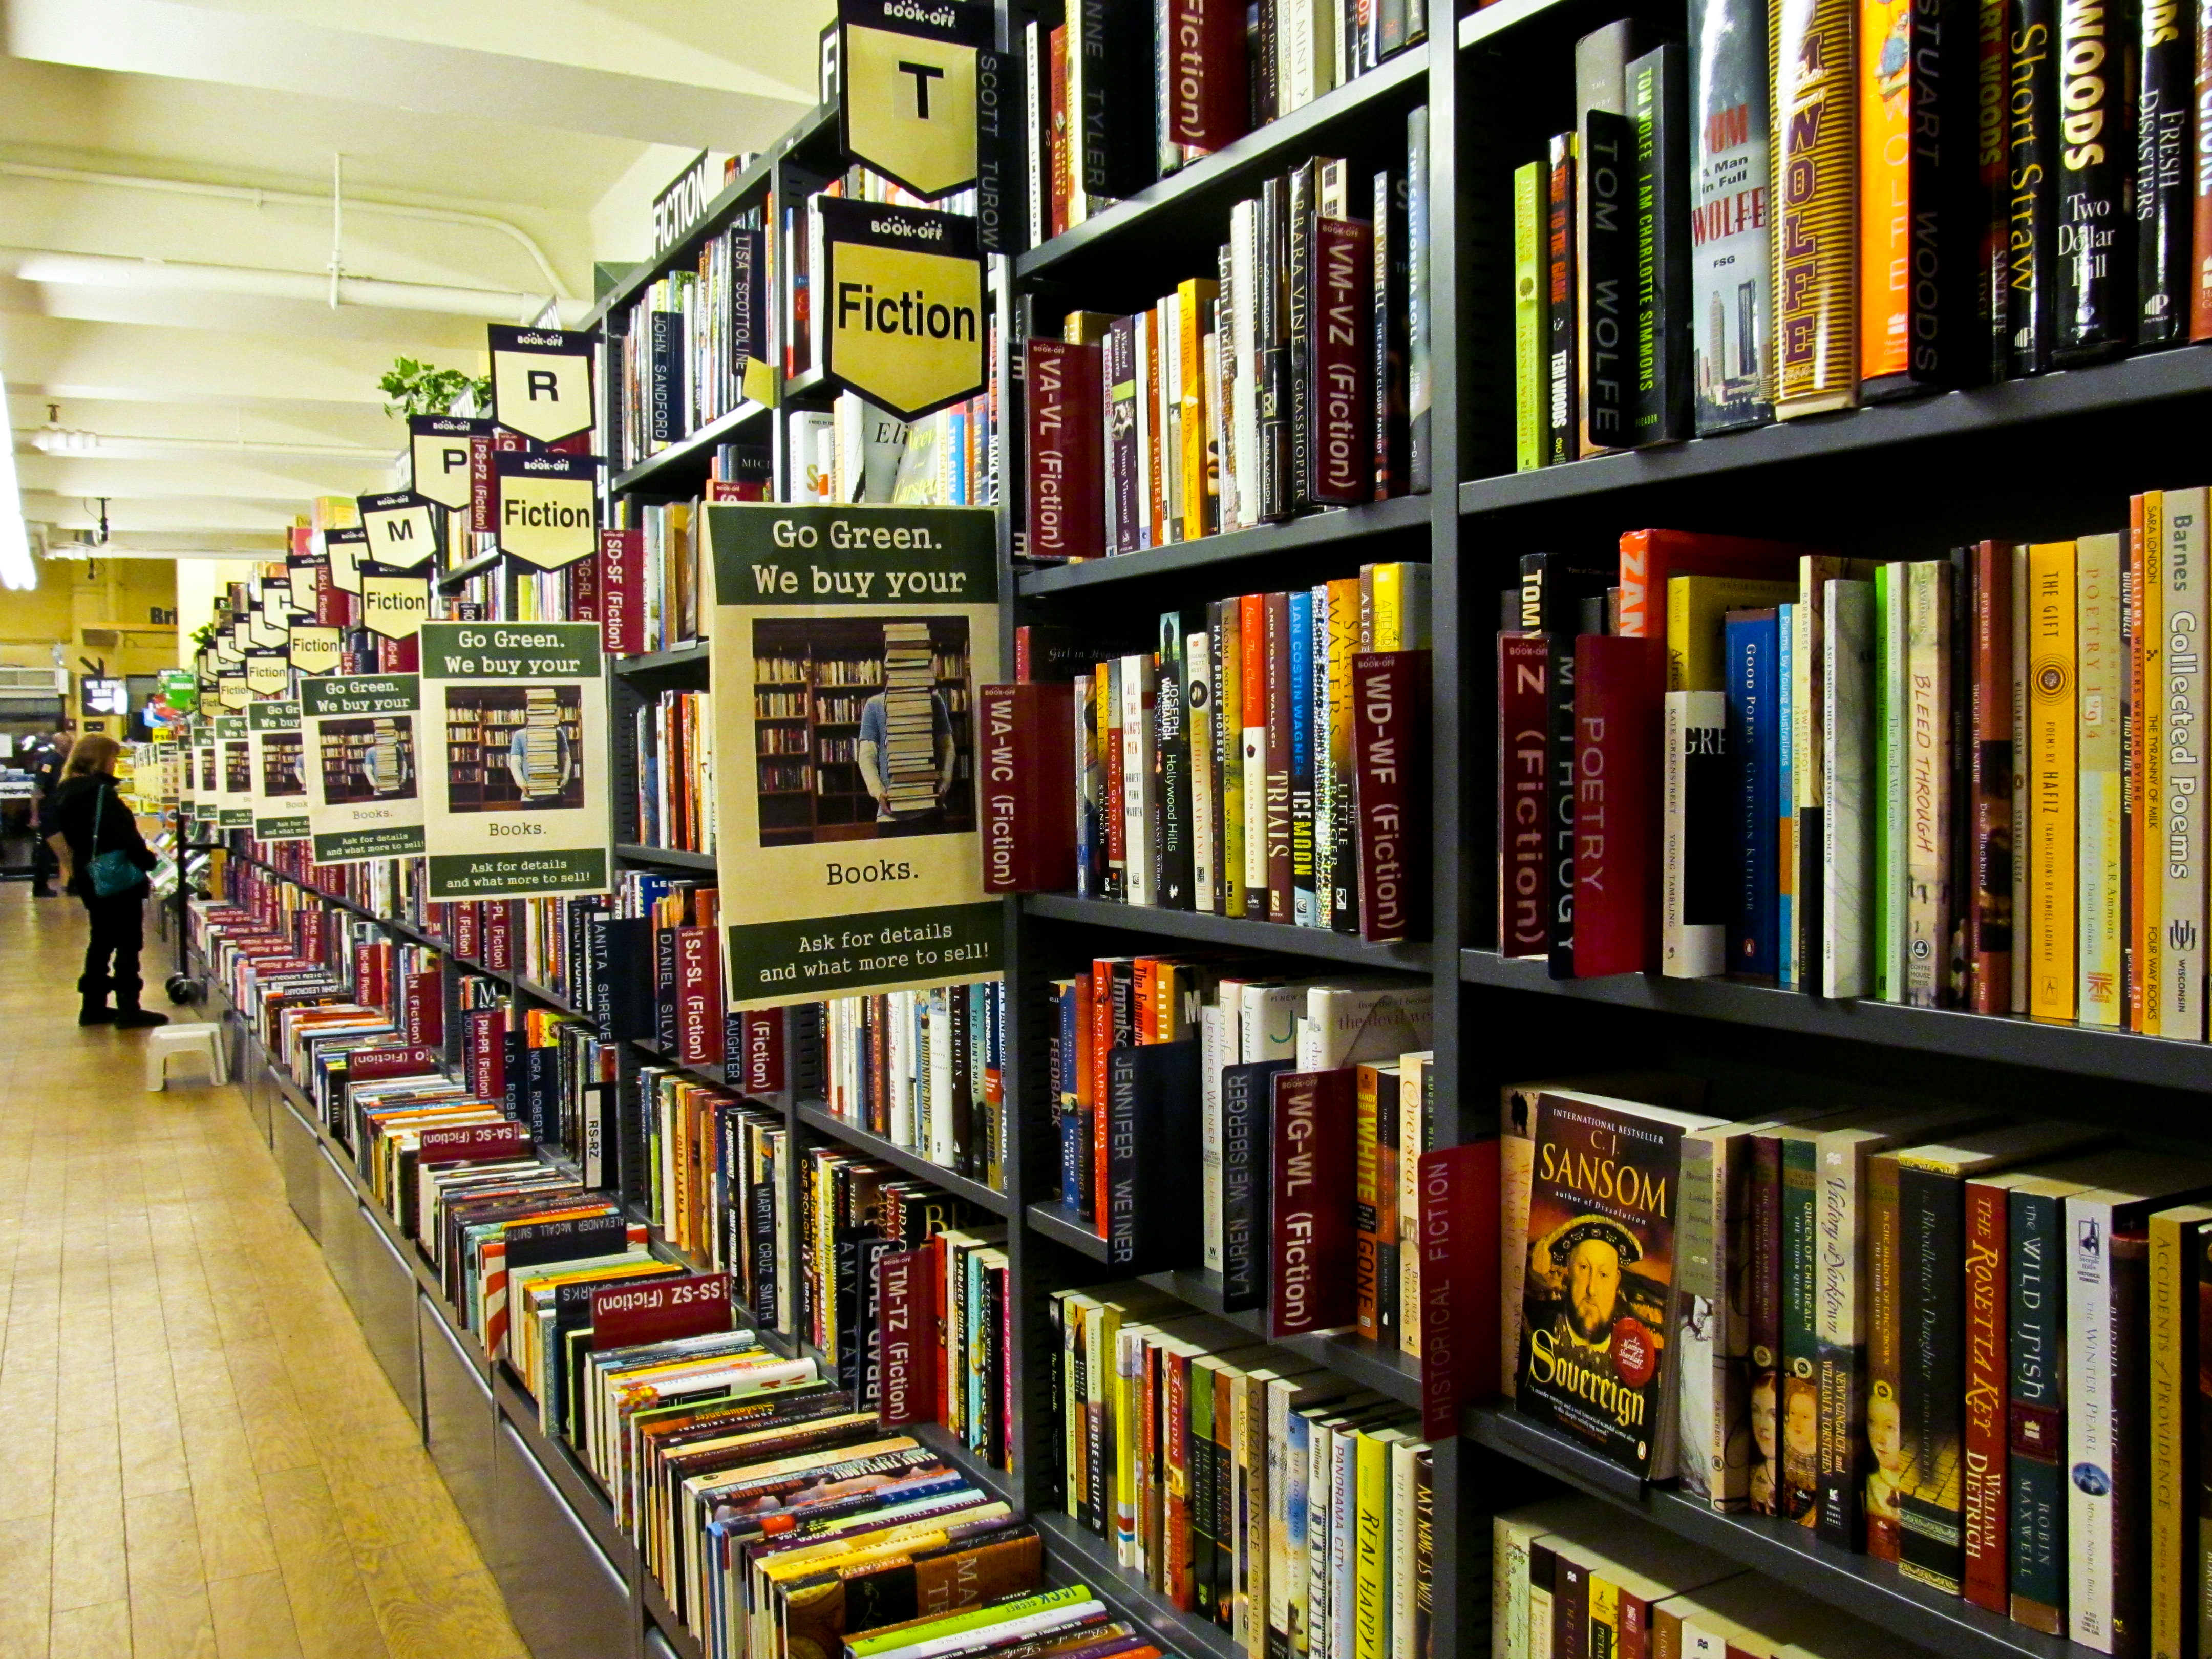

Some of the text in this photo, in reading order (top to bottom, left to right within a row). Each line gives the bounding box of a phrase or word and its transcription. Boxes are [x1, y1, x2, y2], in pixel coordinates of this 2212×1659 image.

[899, 60, 944, 119] T
[1637, 67, 1652, 104] TOM
[981, 55, 999, 249] SCOTT TUROW
[1637, 109, 1652, 161] WOLFE
[2010, 24, 2047, 293] Short Straw
[2136, 89, 2159, 221] DISASTERS
[2158, 110, 2185, 189] FRESH
[1714, 156, 1749, 174] Man
[1719, 169, 1747, 187] Full
[652, 157, 709, 259] FICTION
[1638, 186, 1652, 211] AM
[1693, 186, 1766, 246] WOLFE
[2067, 193, 2110, 222] Two
[1374, 179, 1385, 313] SARAH VOWELL
[1638, 215, 1652, 307] CHARLOTTE
[1713, 255, 1735, 268] FSG
[2058, 225, 2115, 256] Dollar
[736, 236, 750, 370] LISA SCOTTOLINE
[838, 282, 975, 342] Fiction
[1594, 139, 1620, 433] TOM WOLFE
[654, 315, 667, 438] JOHN SANDFORD
[1328, 243, 1356, 487] VM-VZ (Fiction)
[1639, 310, 1653, 391] SIMMONS
[527, 370, 559, 402] R
[443, 449, 467, 474] P
[1038, 358, 1064, 548] VA-VL (Fiction)
[1295, 379, 1305, 499] GRASSHOPPER
[474, 444, 487, 532] PS-PZ (Fiction)
[505, 499, 590, 528] Fiction
[387, 519, 414, 542] M
[773, 521, 943, 551] Go Green.
[607, 540, 622, 583] SD-SF
[752, 565, 967, 600] We buy your
[318, 569, 327, 624] LG-LL (Fiction)
[367, 592, 426, 610] Fiction
[292, 638, 338, 652] Fiction
[444, 656, 580, 675] We buy your
[458, 631, 565, 648] Go Green.
[249, 667, 286, 678] Fiction
[326, 681, 399, 694] Go Green.
[2168, 514, 2197, 880] Barnes Collected Poems
[317, 698, 410, 712] We buy your
[1161, 677, 1171, 740] WAMBAUGH
[1169, 681, 1179, 735] JOSEPH
[353, 809, 393, 819] Books.
[990, 700, 1015, 885] WA-WC (Fiction)
[1266, 771, 1289, 857] TRIALS
[1365, 673, 1405, 930] WD-WF (Fiction)
[1515, 663, 1546, 944] Z (Fiction)
[1581, 717, 1605, 891] POETRY
[327, 847, 342, 856] and
[345, 846, 365, 854] what
[405, 840, 424, 849] sell!
[342, 833, 408, 845] Ask for details
[489, 822, 547, 837] Books.
[446, 872, 590, 888] and what more to sell!
[471, 859, 567, 873] Ask for details
[826, 861, 920, 886] Books.
[759, 943, 989, 983] and what more to sell!
[799, 924, 953, 953] Ask for details
[594, 924, 612, 1041] ANITA SHREVE
[660, 934, 674, 1051] DANIEL SILVA
[685, 939, 706, 1060] SJ-SL (Fiction)
[2177, 959, 2188, 1013] WISCONSIN
[354, 1051, 426, 1065] O (Fiction)
[476, 1019, 491, 1098] PM-PR (Fiction)
[529, 1051, 543, 1143] NORA ROBERTS
[422, 1126, 513, 1144] SA-SC (Fiction)
[589, 1120, 599, 1158] RS-RZ
[1552, 1108, 1665, 1146] INTERNATIONAL BESTSELLER
[1114, 1057, 1133, 1263] JENNIFER WEINER
[1540, 1143, 1668, 1219] SANSOM
[1284, 1093, 1311, 1327] WG-WL (Fiction)
[1594, 1201, 1647, 1226] Dissolution
[756, 1188, 773, 1321] MARTIN CRUZ SMITH
[597, 1281, 721, 1313] SS-SZ (Fiction)
[1427, 1162, 1452, 1424] FICTION HISTORICAL
[1965, 1197, 1999, 1438] THE ROSETTA KEY
[888, 1265, 909, 1421] TM-TZ (Fiction)
[1529, 1328, 1645, 1427] Sovereign
[1335, 1445, 1344, 1573] PANORAMA CITY
[1965, 1449, 1988, 1559] DIETRICH
[1983, 1474, 2001, 1548] WILLIAM
[1359, 1508, 1379, 1652] REAL HAPPY
